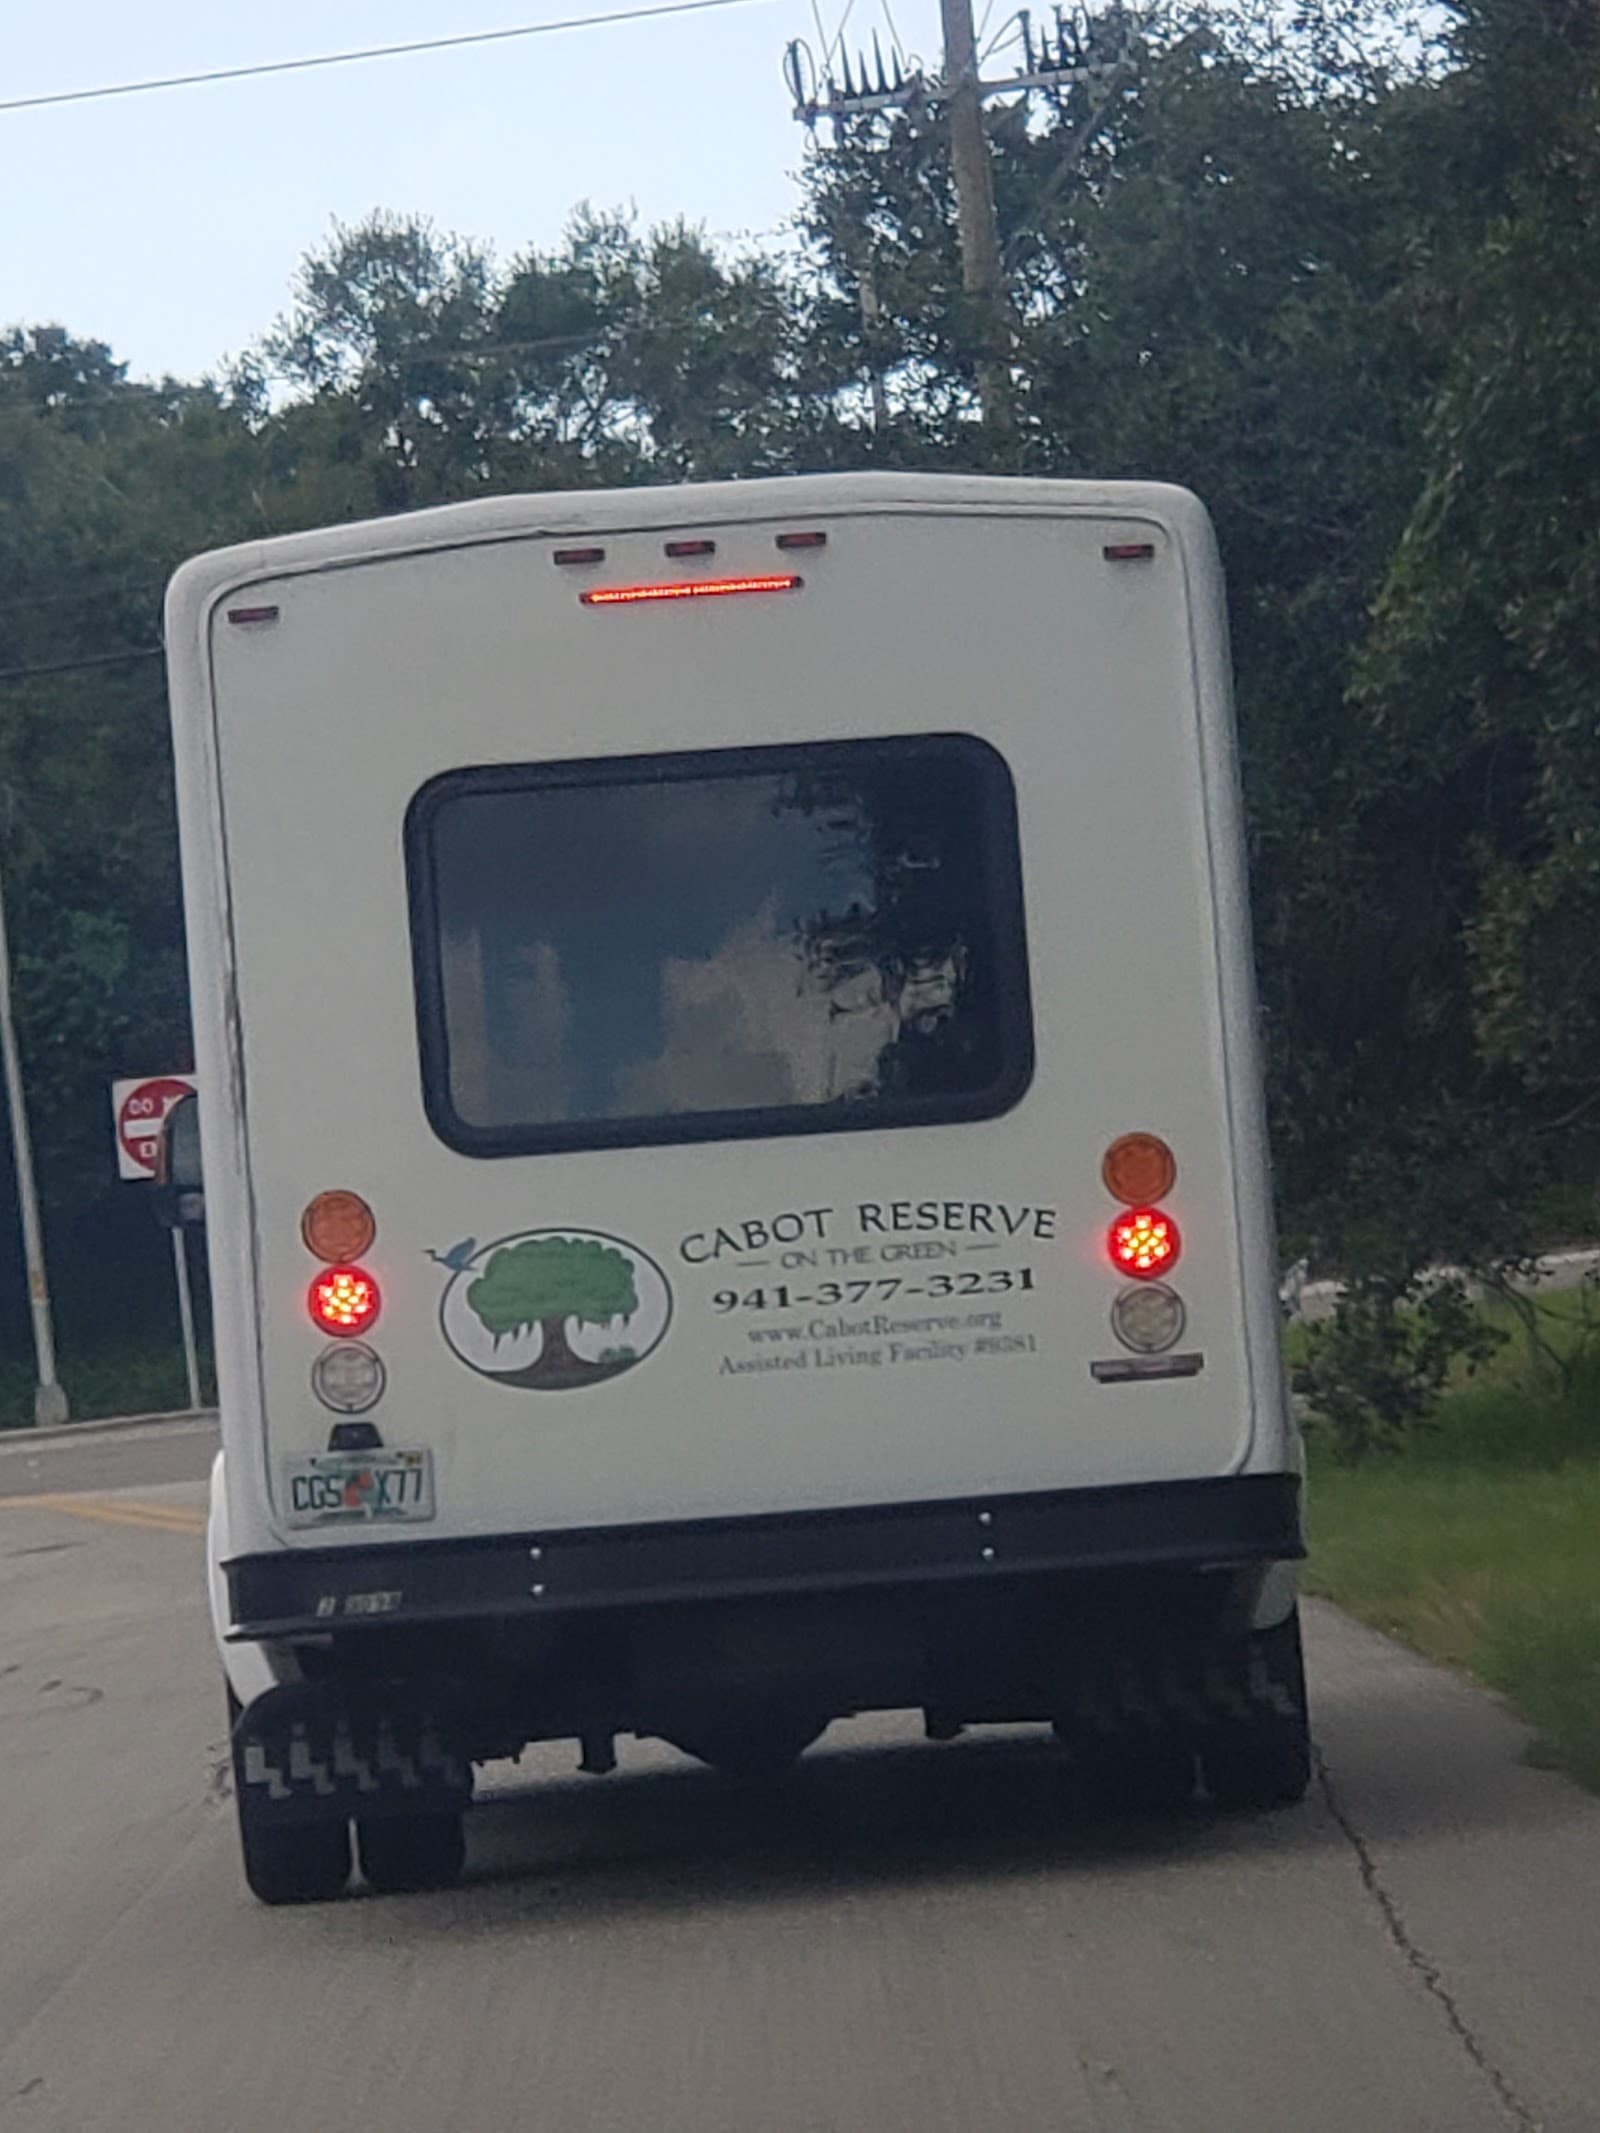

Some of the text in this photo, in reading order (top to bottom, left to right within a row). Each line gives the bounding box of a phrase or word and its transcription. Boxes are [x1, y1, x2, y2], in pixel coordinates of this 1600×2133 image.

[680, 1202, 1057, 1264] CABOT RESERVE
[780, 1240, 958, 1270] ON THE GREEN
[712, 1267, 1036, 1314] 941-377-3231
[747, 1310, 1003, 1344] www.CabotReserve.org
[718, 1350, 808, 1376] Assisted
[815, 1344, 883, 1368] Living
[889, 1340, 966, 1363] Facility
[292, 1468, 423, 1512] CGS X77
